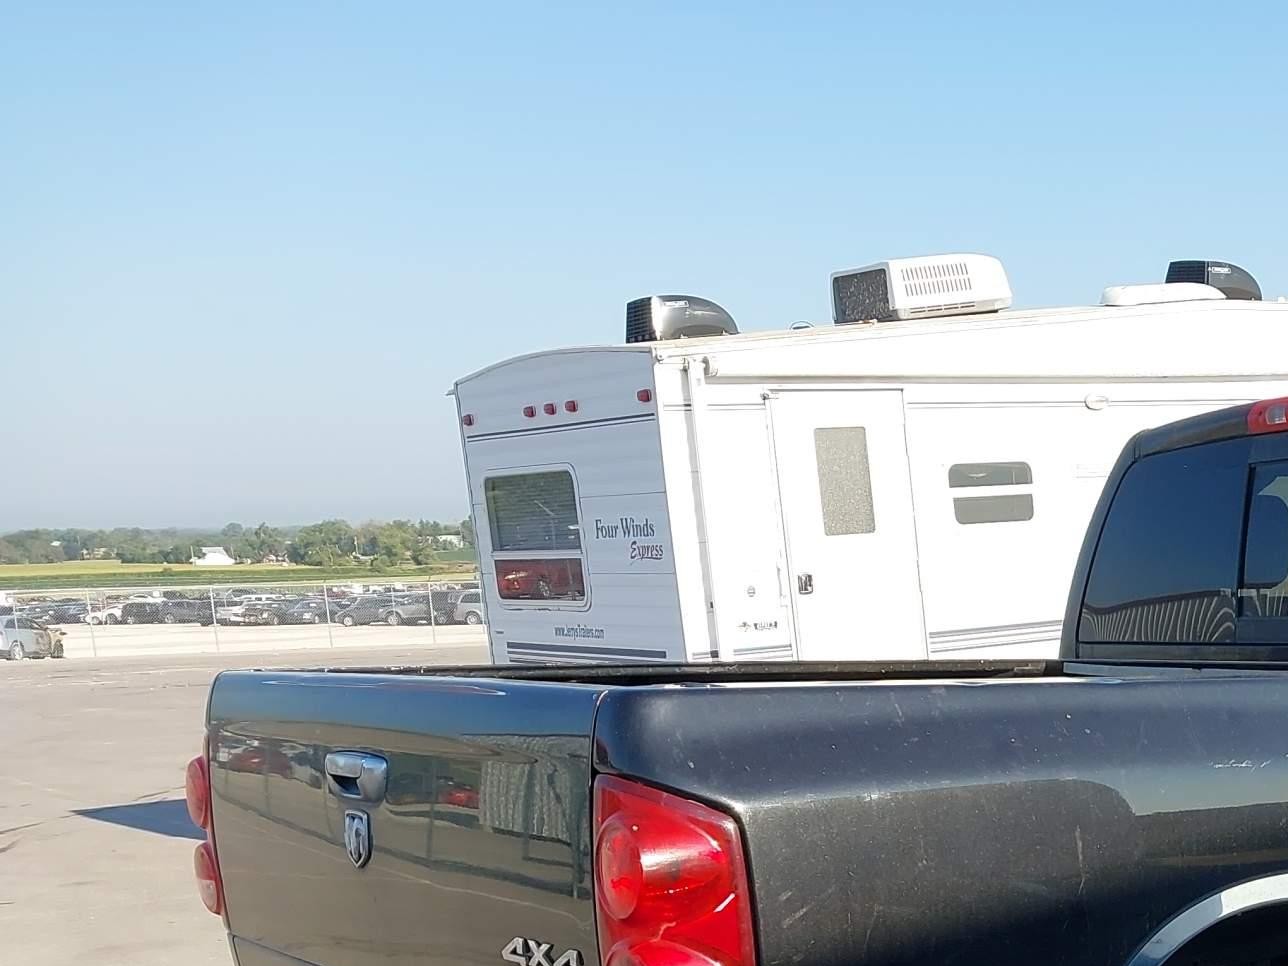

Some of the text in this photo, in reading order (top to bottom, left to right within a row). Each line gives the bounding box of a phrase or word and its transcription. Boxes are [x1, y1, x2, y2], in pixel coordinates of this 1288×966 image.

[595, 517, 655, 539] Four Winds
[630, 540, 664, 561] Express
